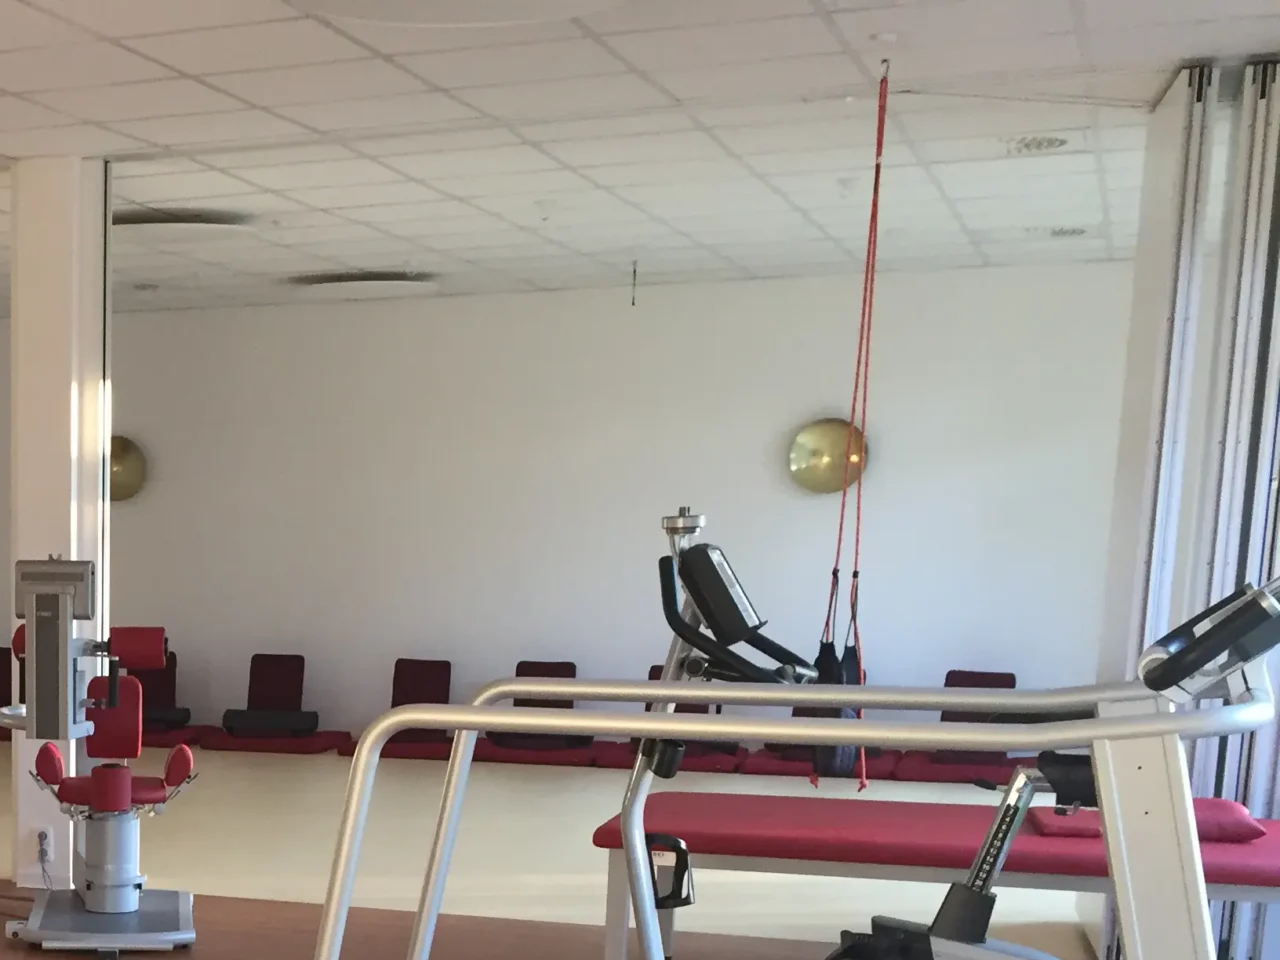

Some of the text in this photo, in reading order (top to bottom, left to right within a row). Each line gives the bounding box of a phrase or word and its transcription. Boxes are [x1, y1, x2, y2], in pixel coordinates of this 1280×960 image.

[993, 839, 1001, 847] 10
[986, 855, 994, 863] 14
[982, 863, 990, 871] 16
